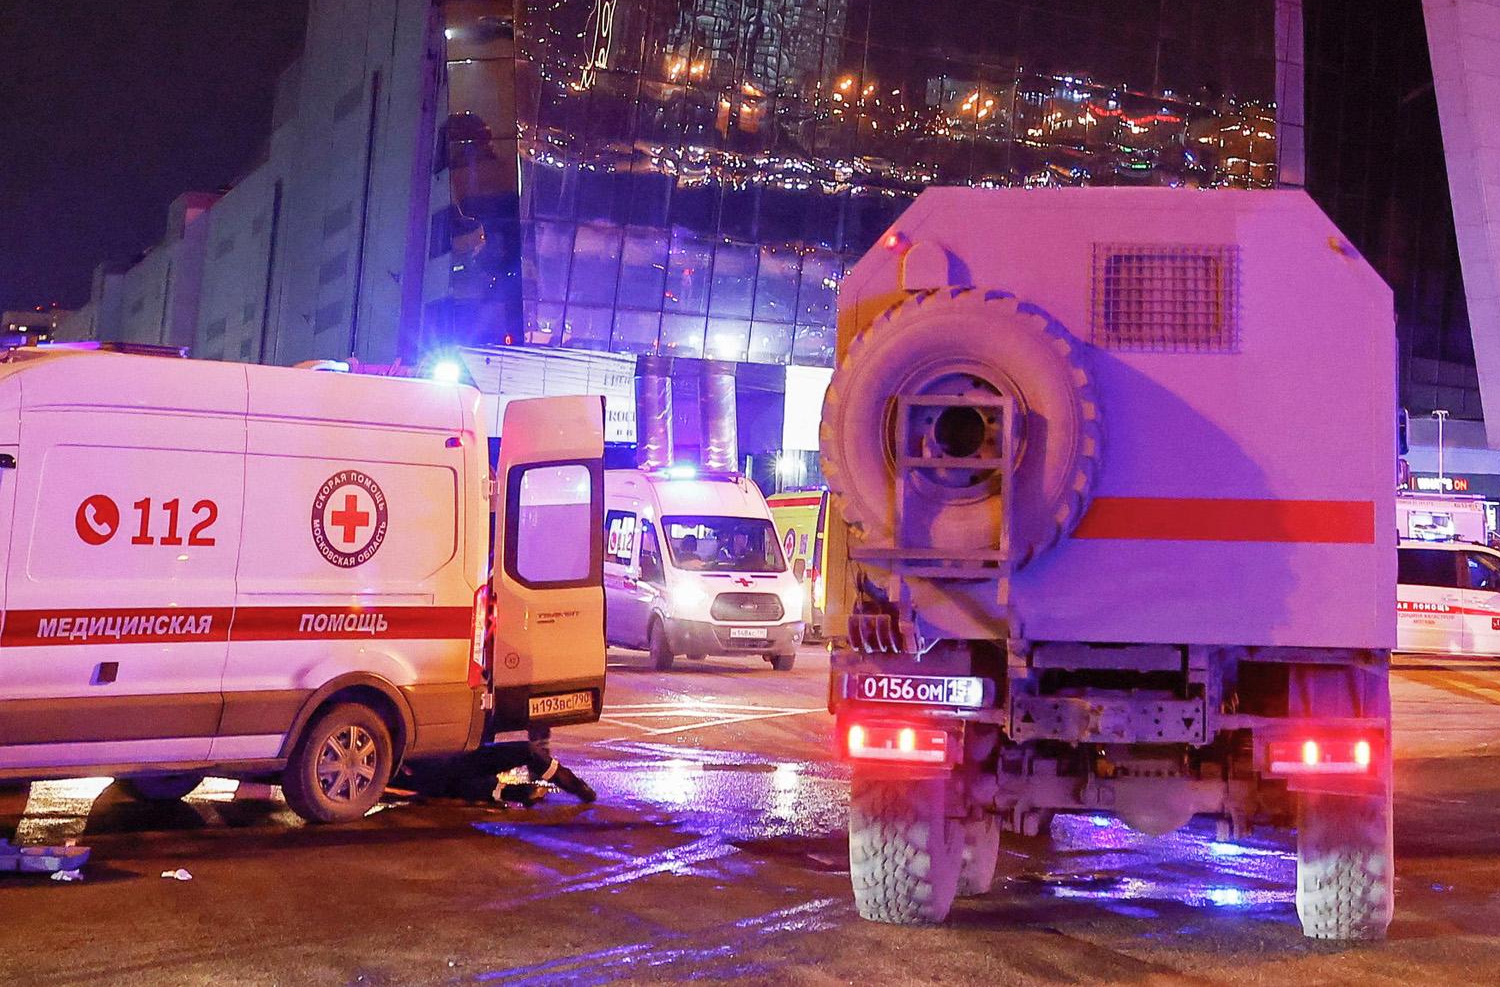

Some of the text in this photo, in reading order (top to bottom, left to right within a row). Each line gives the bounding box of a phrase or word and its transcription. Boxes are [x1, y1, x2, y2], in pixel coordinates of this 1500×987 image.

[315, 472, 385, 511] СКОРАЯ ПОМОЩЬ
[1454, 478, 1468, 491] ON
[131, 497, 218, 546] 112
[313, 518, 387, 567] МОСКОВСКАЯ ОБЛАСТЬ
[1413, 603, 1450, 612] ПОМОЩЬ
[37, 613, 389, 641] МЕДИЦИНСКАЯ ПОМОЩЬ
